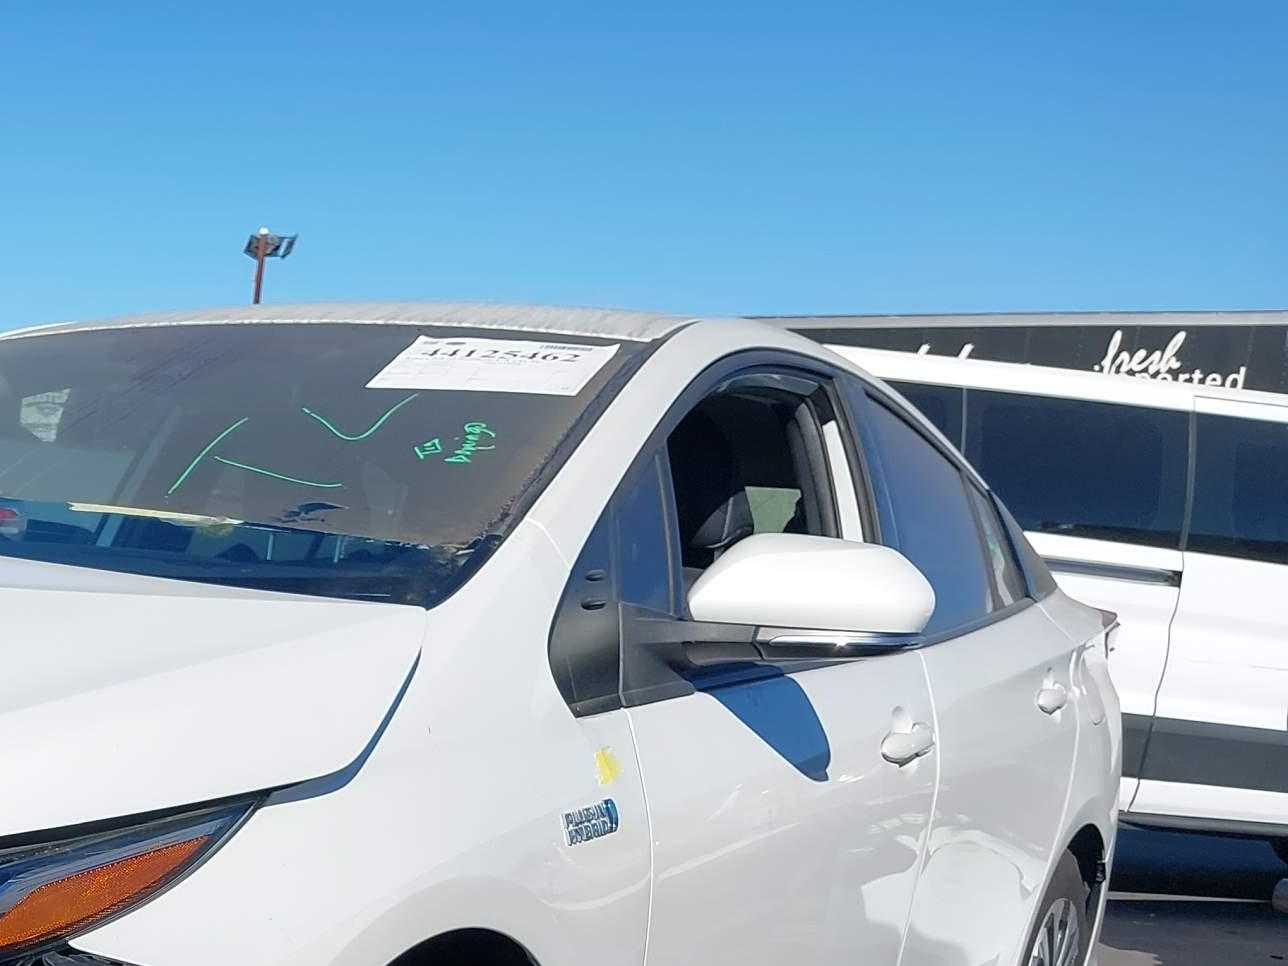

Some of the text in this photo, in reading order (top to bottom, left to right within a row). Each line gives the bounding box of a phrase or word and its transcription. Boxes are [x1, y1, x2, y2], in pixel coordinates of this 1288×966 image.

[420, 347, 581, 363] 44125462
[1094, 329, 1187, 375] fresh
[566, 819, 608, 847] HYBRID
